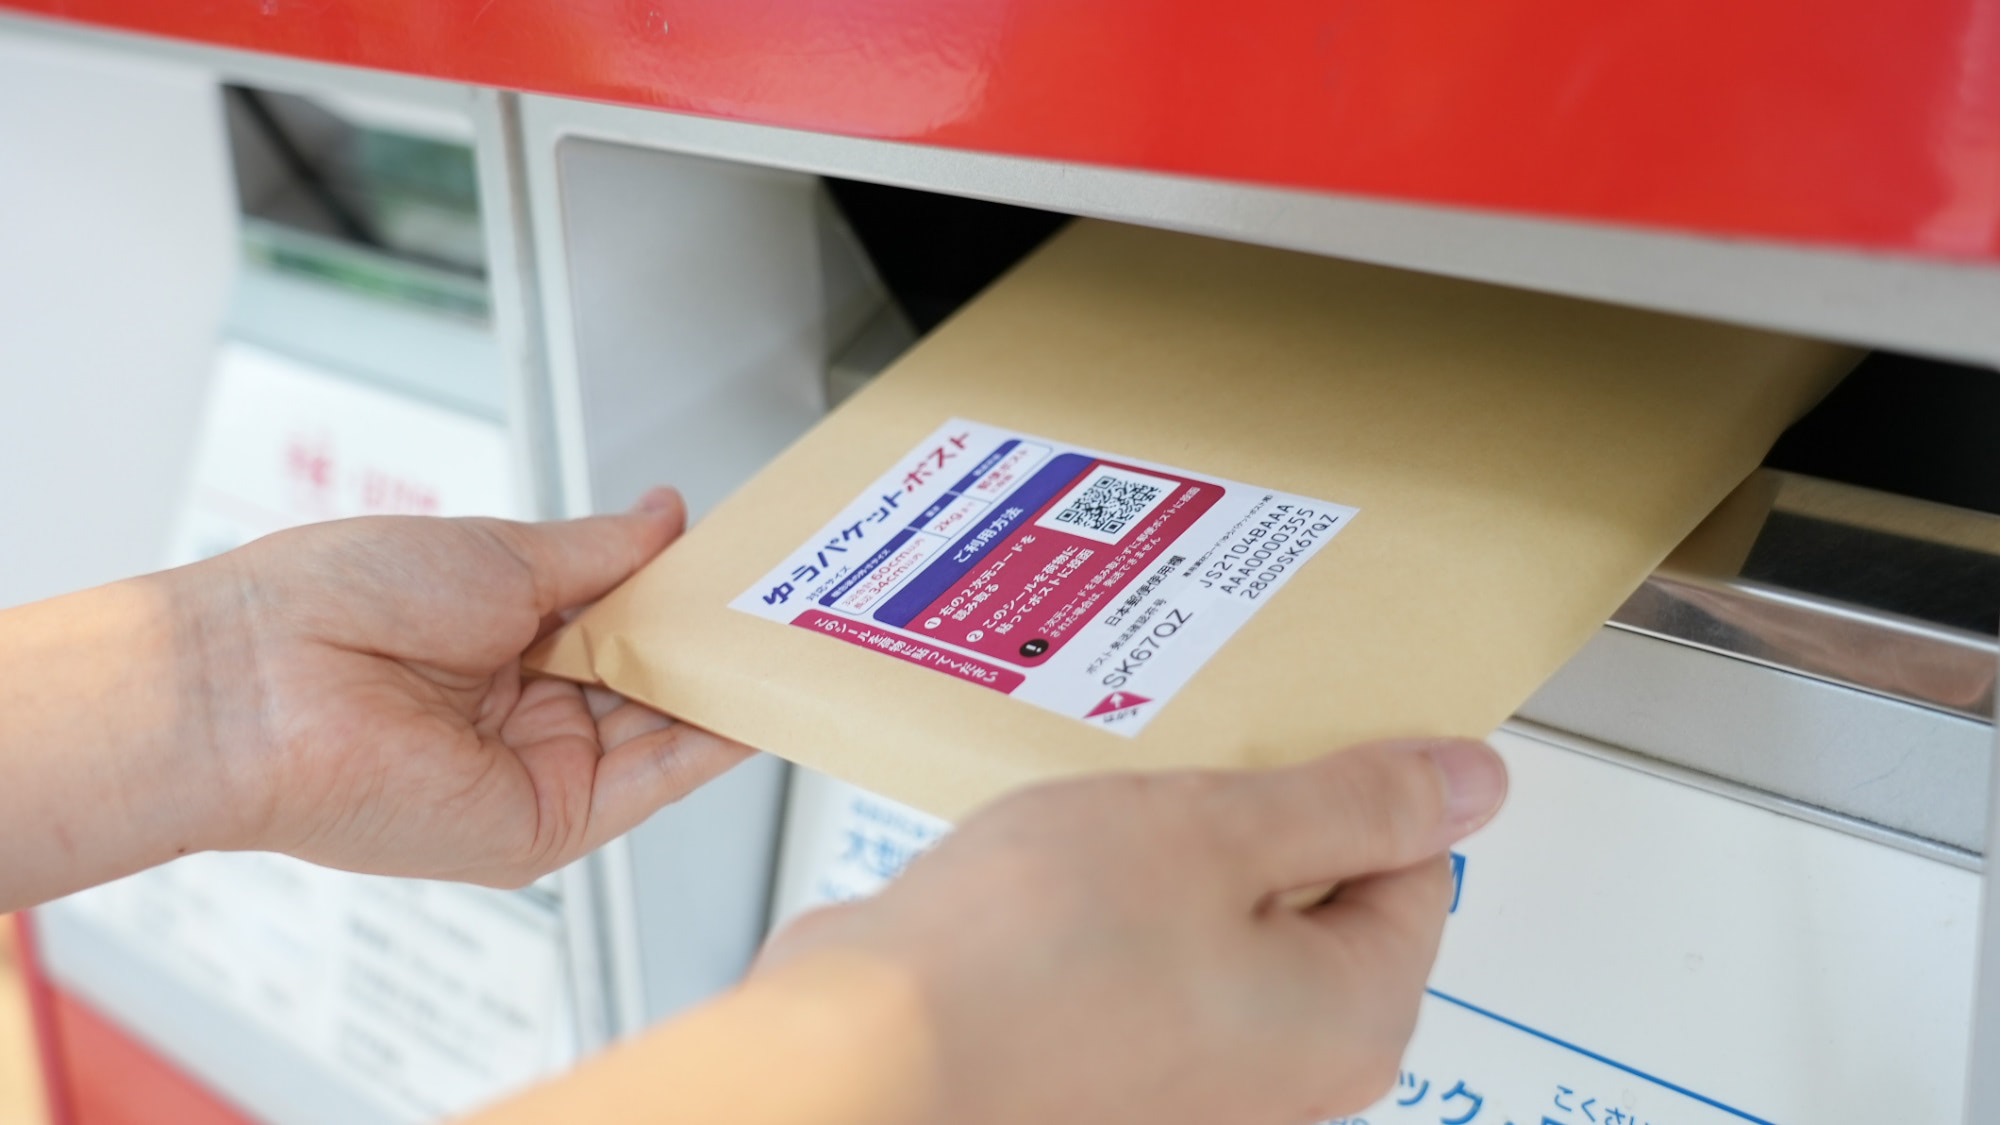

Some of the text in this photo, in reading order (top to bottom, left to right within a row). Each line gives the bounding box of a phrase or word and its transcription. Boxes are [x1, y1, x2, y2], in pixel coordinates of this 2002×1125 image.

[761, 430, 969, 605] ゆうパケットポスト
[952, 507, 1023, 563] ご利用方法
[1199, 504, 1294, 588] JS2104BAAA
[1219, 507, 1314, 594] AAA0000355
[1239, 513, 1339, 599] 280DSK67QZ
[805, 564, 850, 601] 対応サイズ
[951, 583, 999, 621] 読み取る
[982, 545, 1078, 628] このシールを荷物に
[994, 548, 1094, 634] 貼ってポストに投函
[1104, 554, 1186, 626] 日本郵便使用欄
[813, 617, 998, 682] このシールを荷物に貼ってください
[1086, 598, 1167, 673] ポスト発送確認符号
[1101, 607, 1193, 688] SK67QZ
